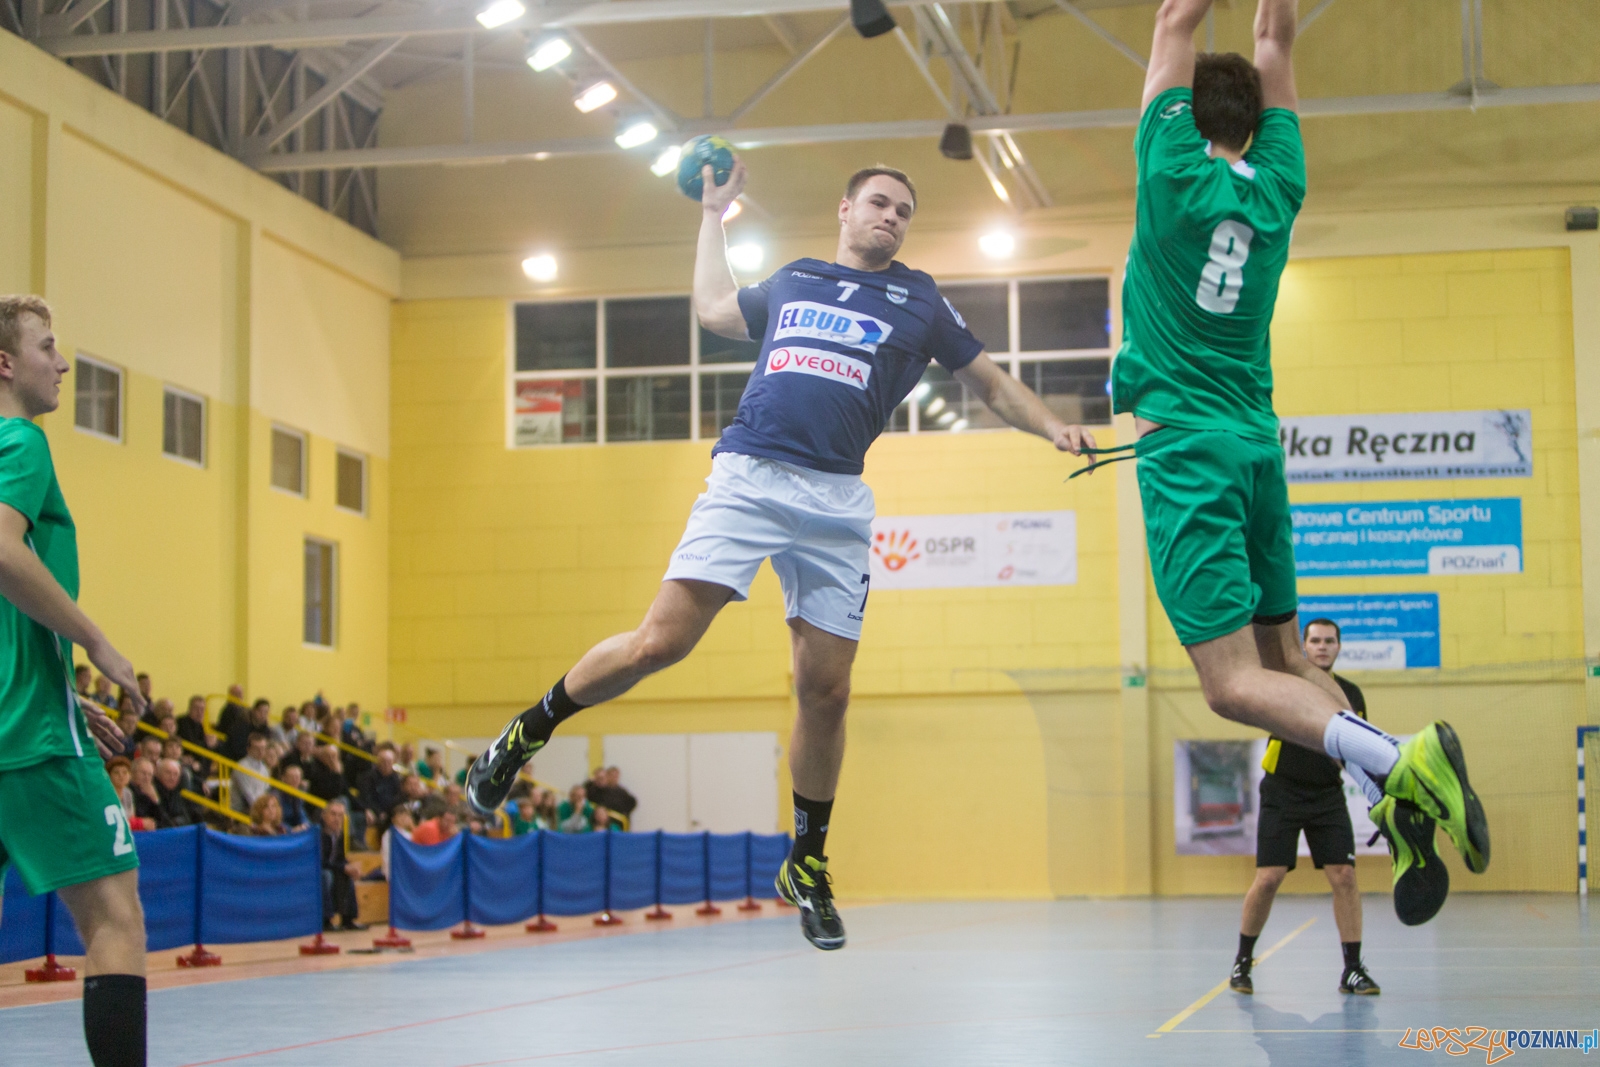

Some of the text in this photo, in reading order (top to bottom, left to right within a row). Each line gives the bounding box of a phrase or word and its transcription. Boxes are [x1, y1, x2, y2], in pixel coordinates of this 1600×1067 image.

[1196, 219, 1254, 314] 8
[836, 280, 861, 302] 7
[780, 308, 852, 334] ELBUD
[795, 354, 864, 384] VEOLIA
[1280, 426, 1476, 463] łka Ręczna
[1346, 507, 1425, 526] Centrum
[1428, 504, 1492, 526] Sportu
[925, 537, 976, 554] OSPR
